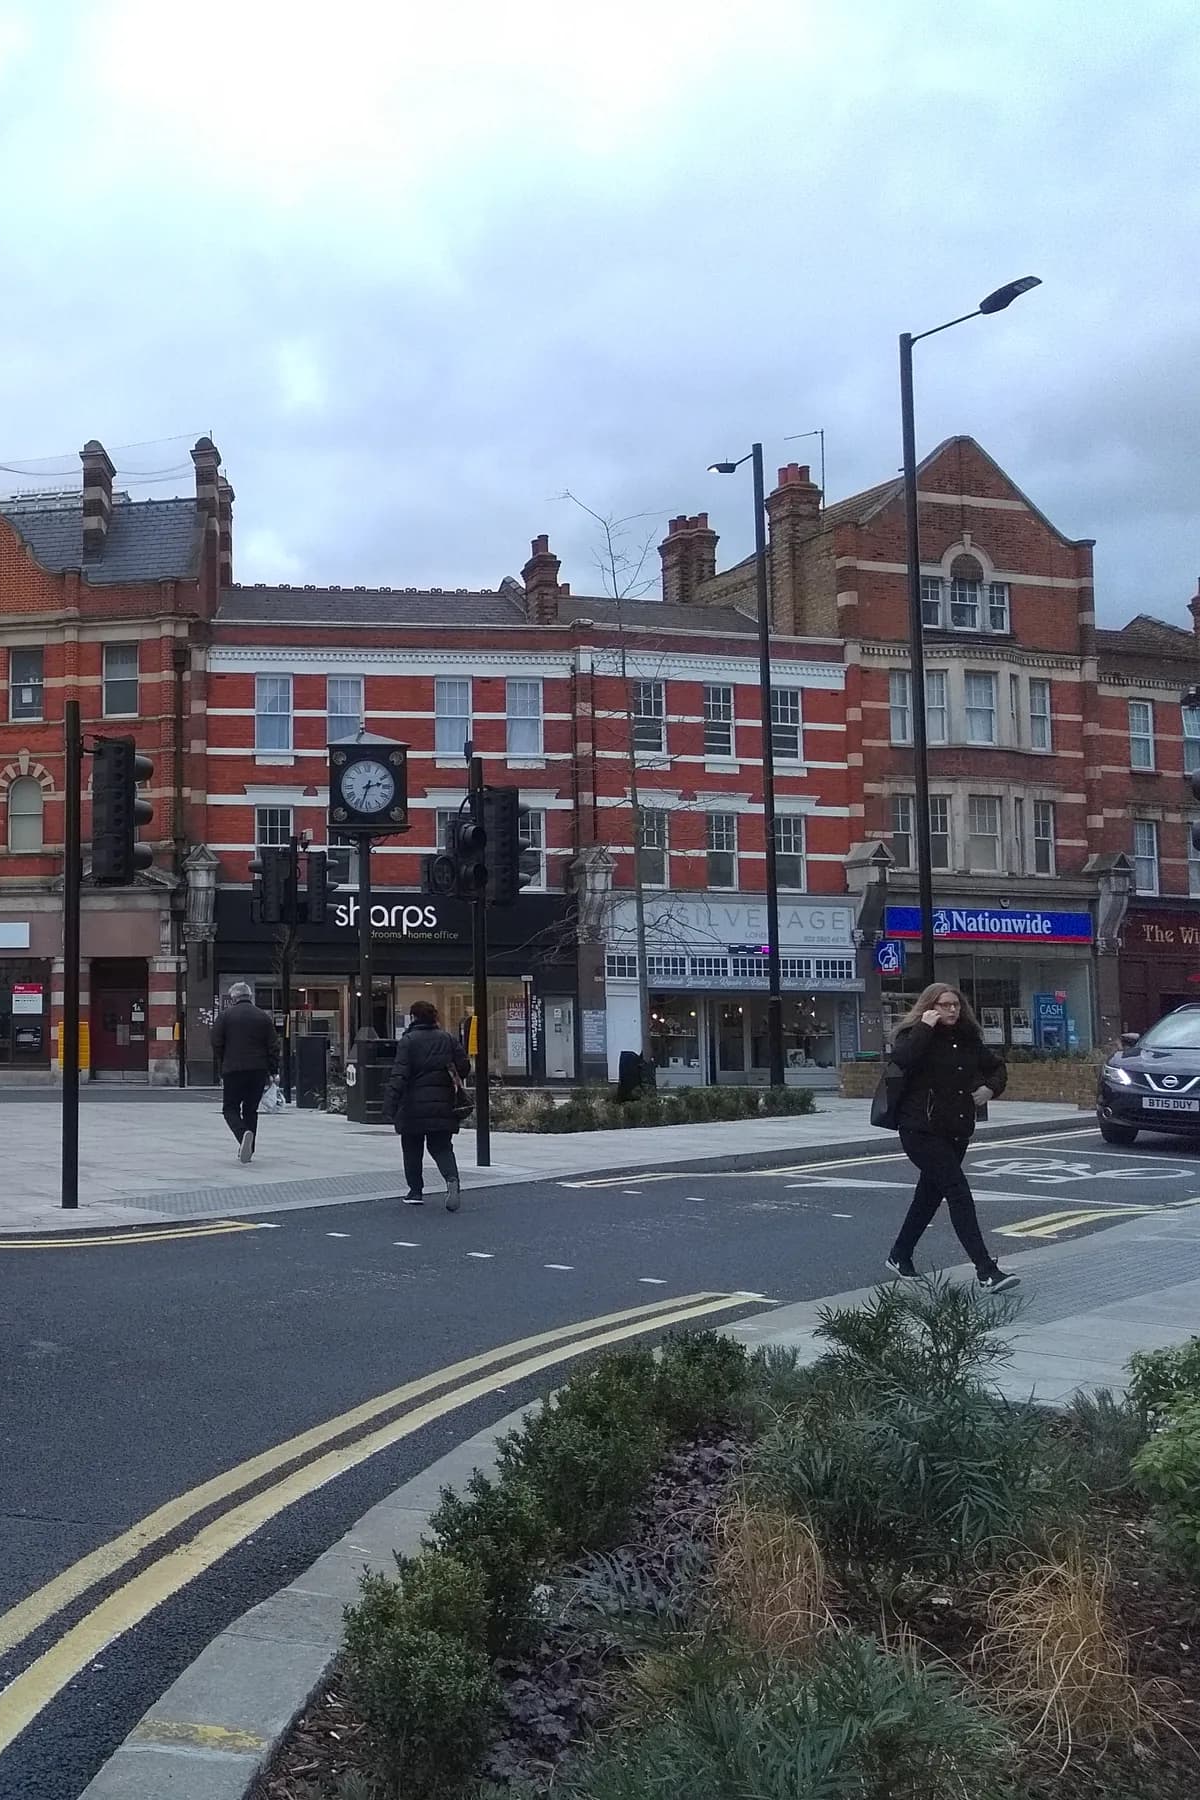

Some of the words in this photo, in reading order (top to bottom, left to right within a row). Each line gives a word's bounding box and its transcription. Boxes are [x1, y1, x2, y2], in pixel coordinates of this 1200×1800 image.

[335, 896, 437, 935] sharps
[676, 907, 846, 931] SILVEAGE
[952, 911, 1052, 934] Nationwide
[358, 929, 402, 939] drooms
[408, 930, 432, 940] home
[434, 930, 459, 940] office
[745, 930, 769, 939] LOND
[1142, 924, 1174, 943] The
[1040, 1004, 1063, 1015] CASH
[1148, 1098, 1170, 1108] BT15
[1172, 1100, 1193, 1109] DUY
